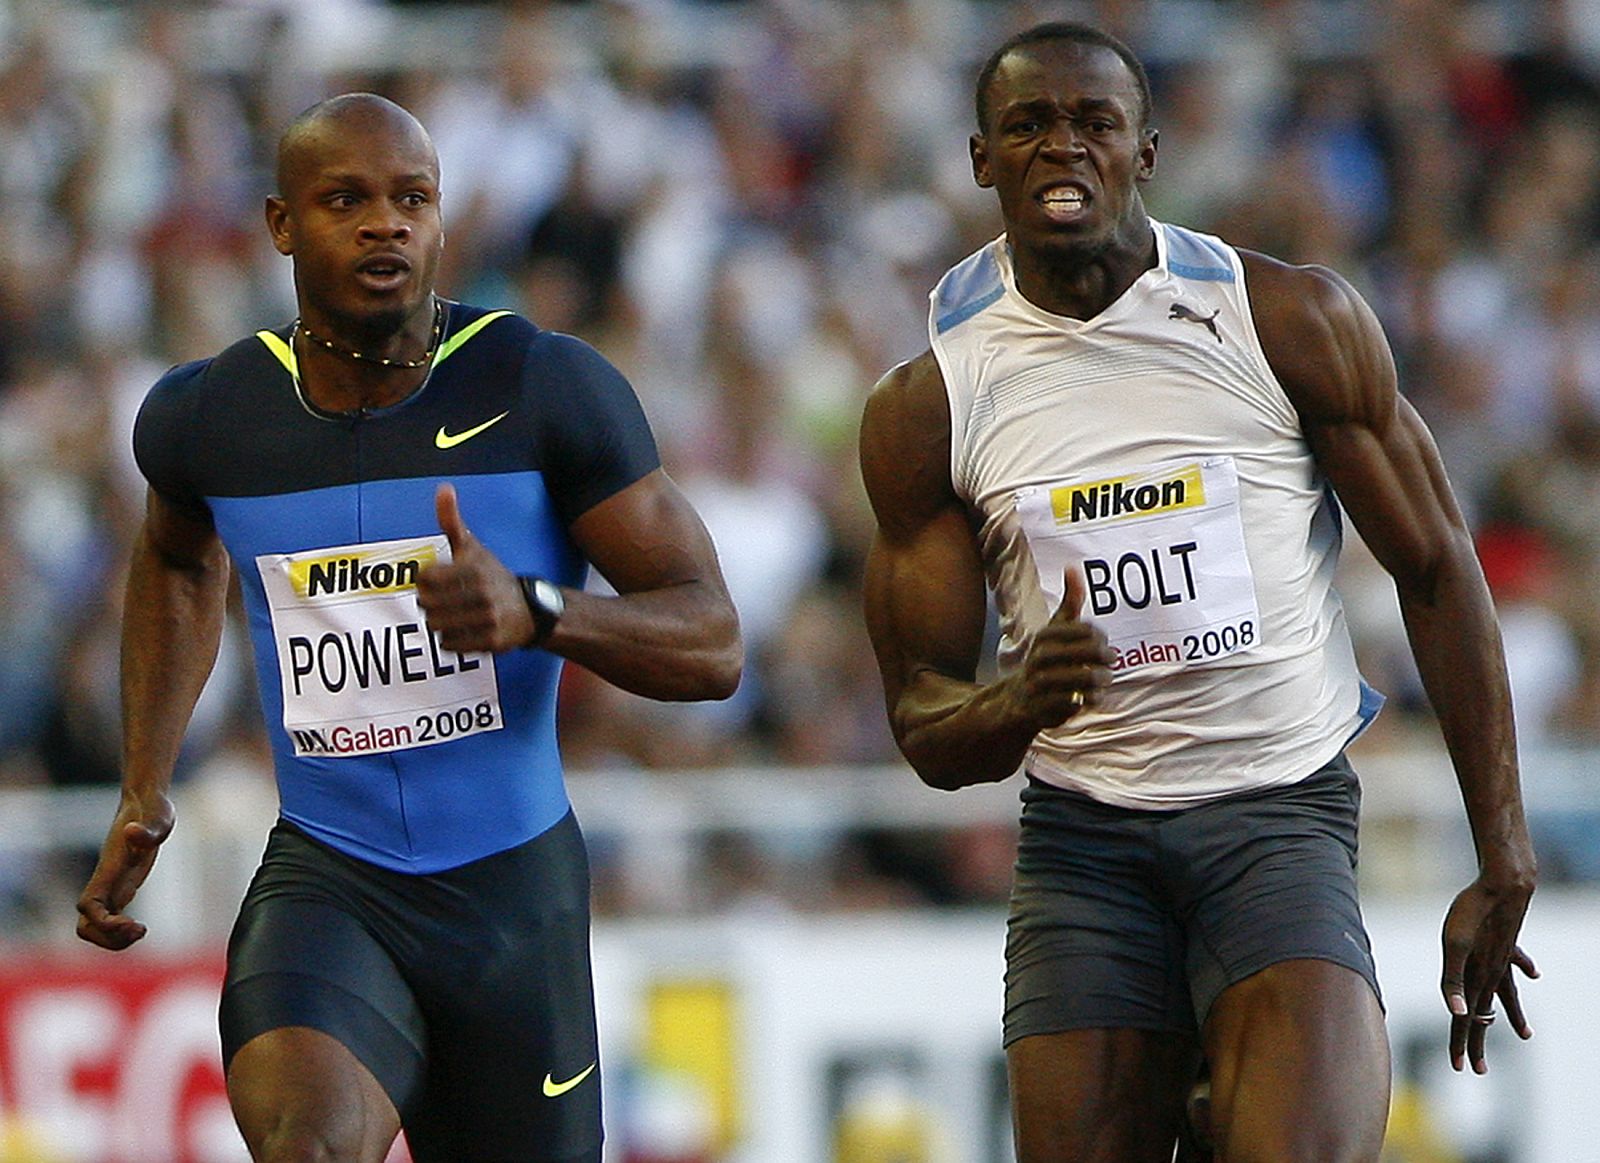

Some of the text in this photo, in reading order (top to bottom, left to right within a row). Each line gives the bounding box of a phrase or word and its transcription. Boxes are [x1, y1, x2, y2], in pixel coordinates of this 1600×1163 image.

[1071, 479, 1185, 522] Nikon
[308, 558, 420, 597] Nikon
[1084, 542, 1198, 616] BOLT
[1183, 621, 1255, 661] 2008
[416, 702, 495, 742] 2008
